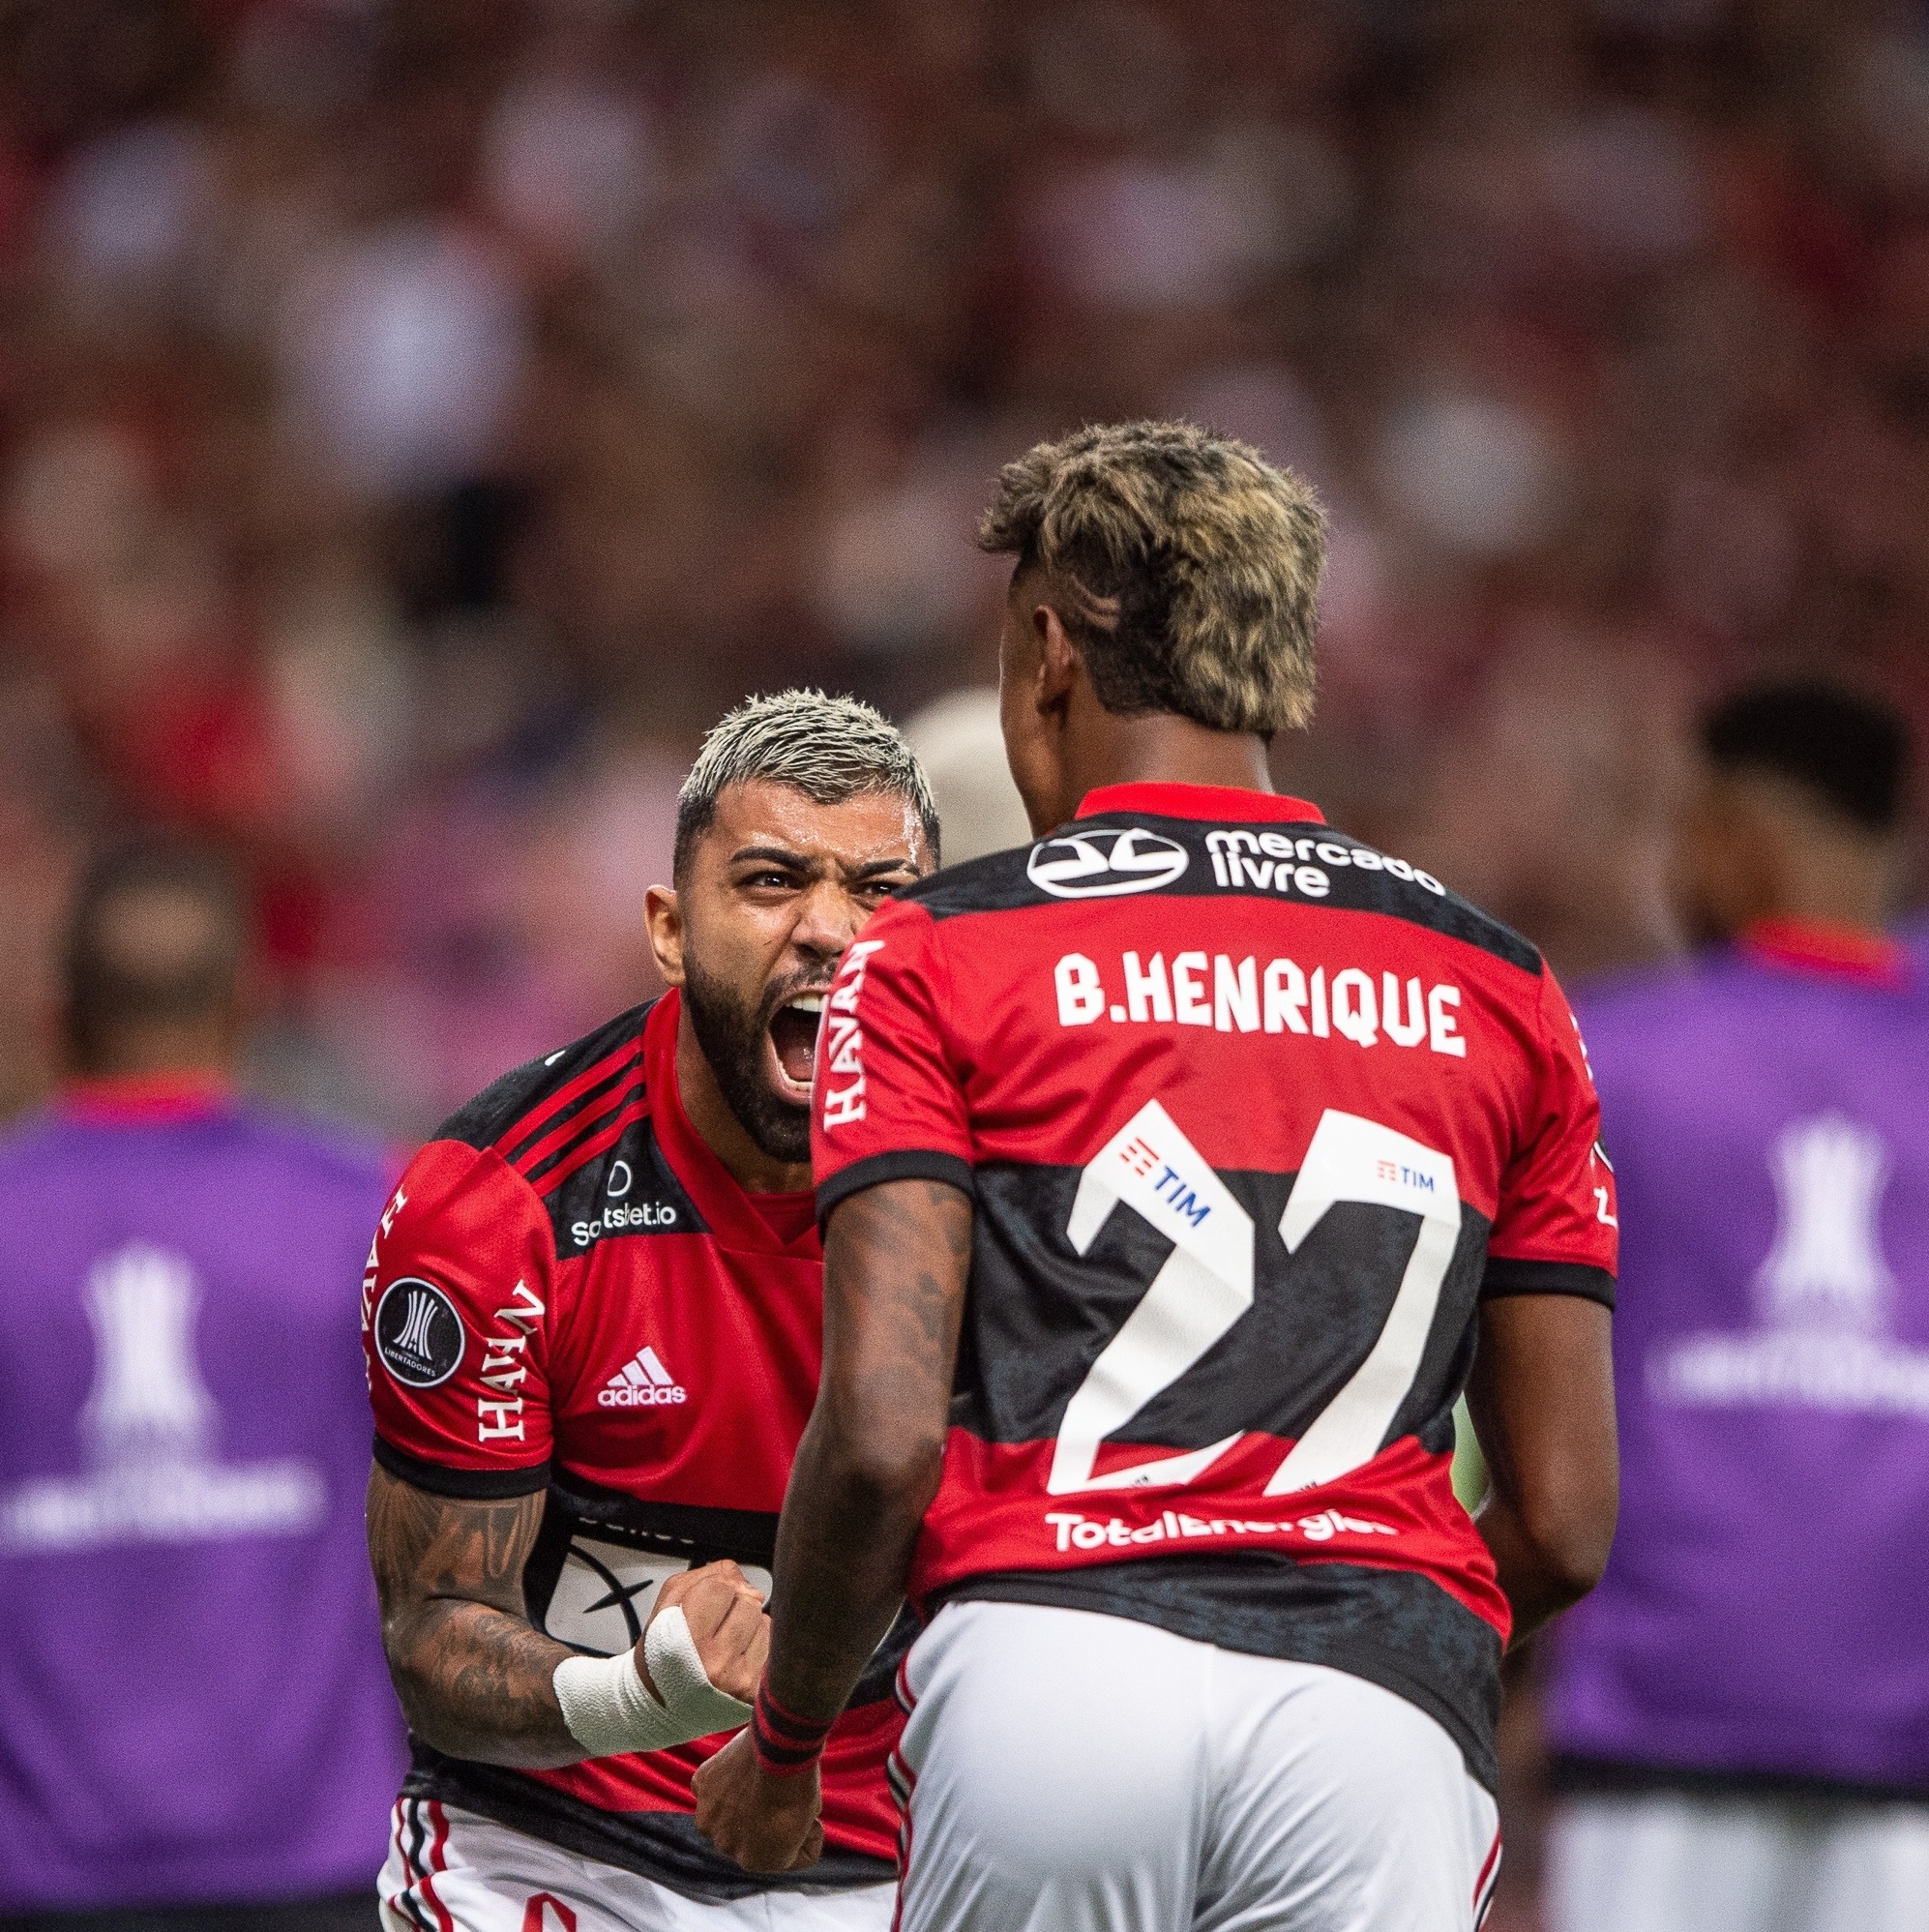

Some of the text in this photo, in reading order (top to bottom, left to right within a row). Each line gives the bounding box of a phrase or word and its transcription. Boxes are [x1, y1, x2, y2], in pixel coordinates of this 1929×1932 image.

[1204, 830, 1446, 897] mercado
[1210, 850, 1330, 898] livre
[1054, 949, 1467, 1058] B.HENRIQUE
[1154, 1164, 1213, 1228] TIM
[1399, 1165, 1436, 1194] TIM
[1047, 1098, 1462, 1498] 27
[384, 1346, 436, 1378] LIBERTADORES
[597, 1383, 688, 1407] adidas
